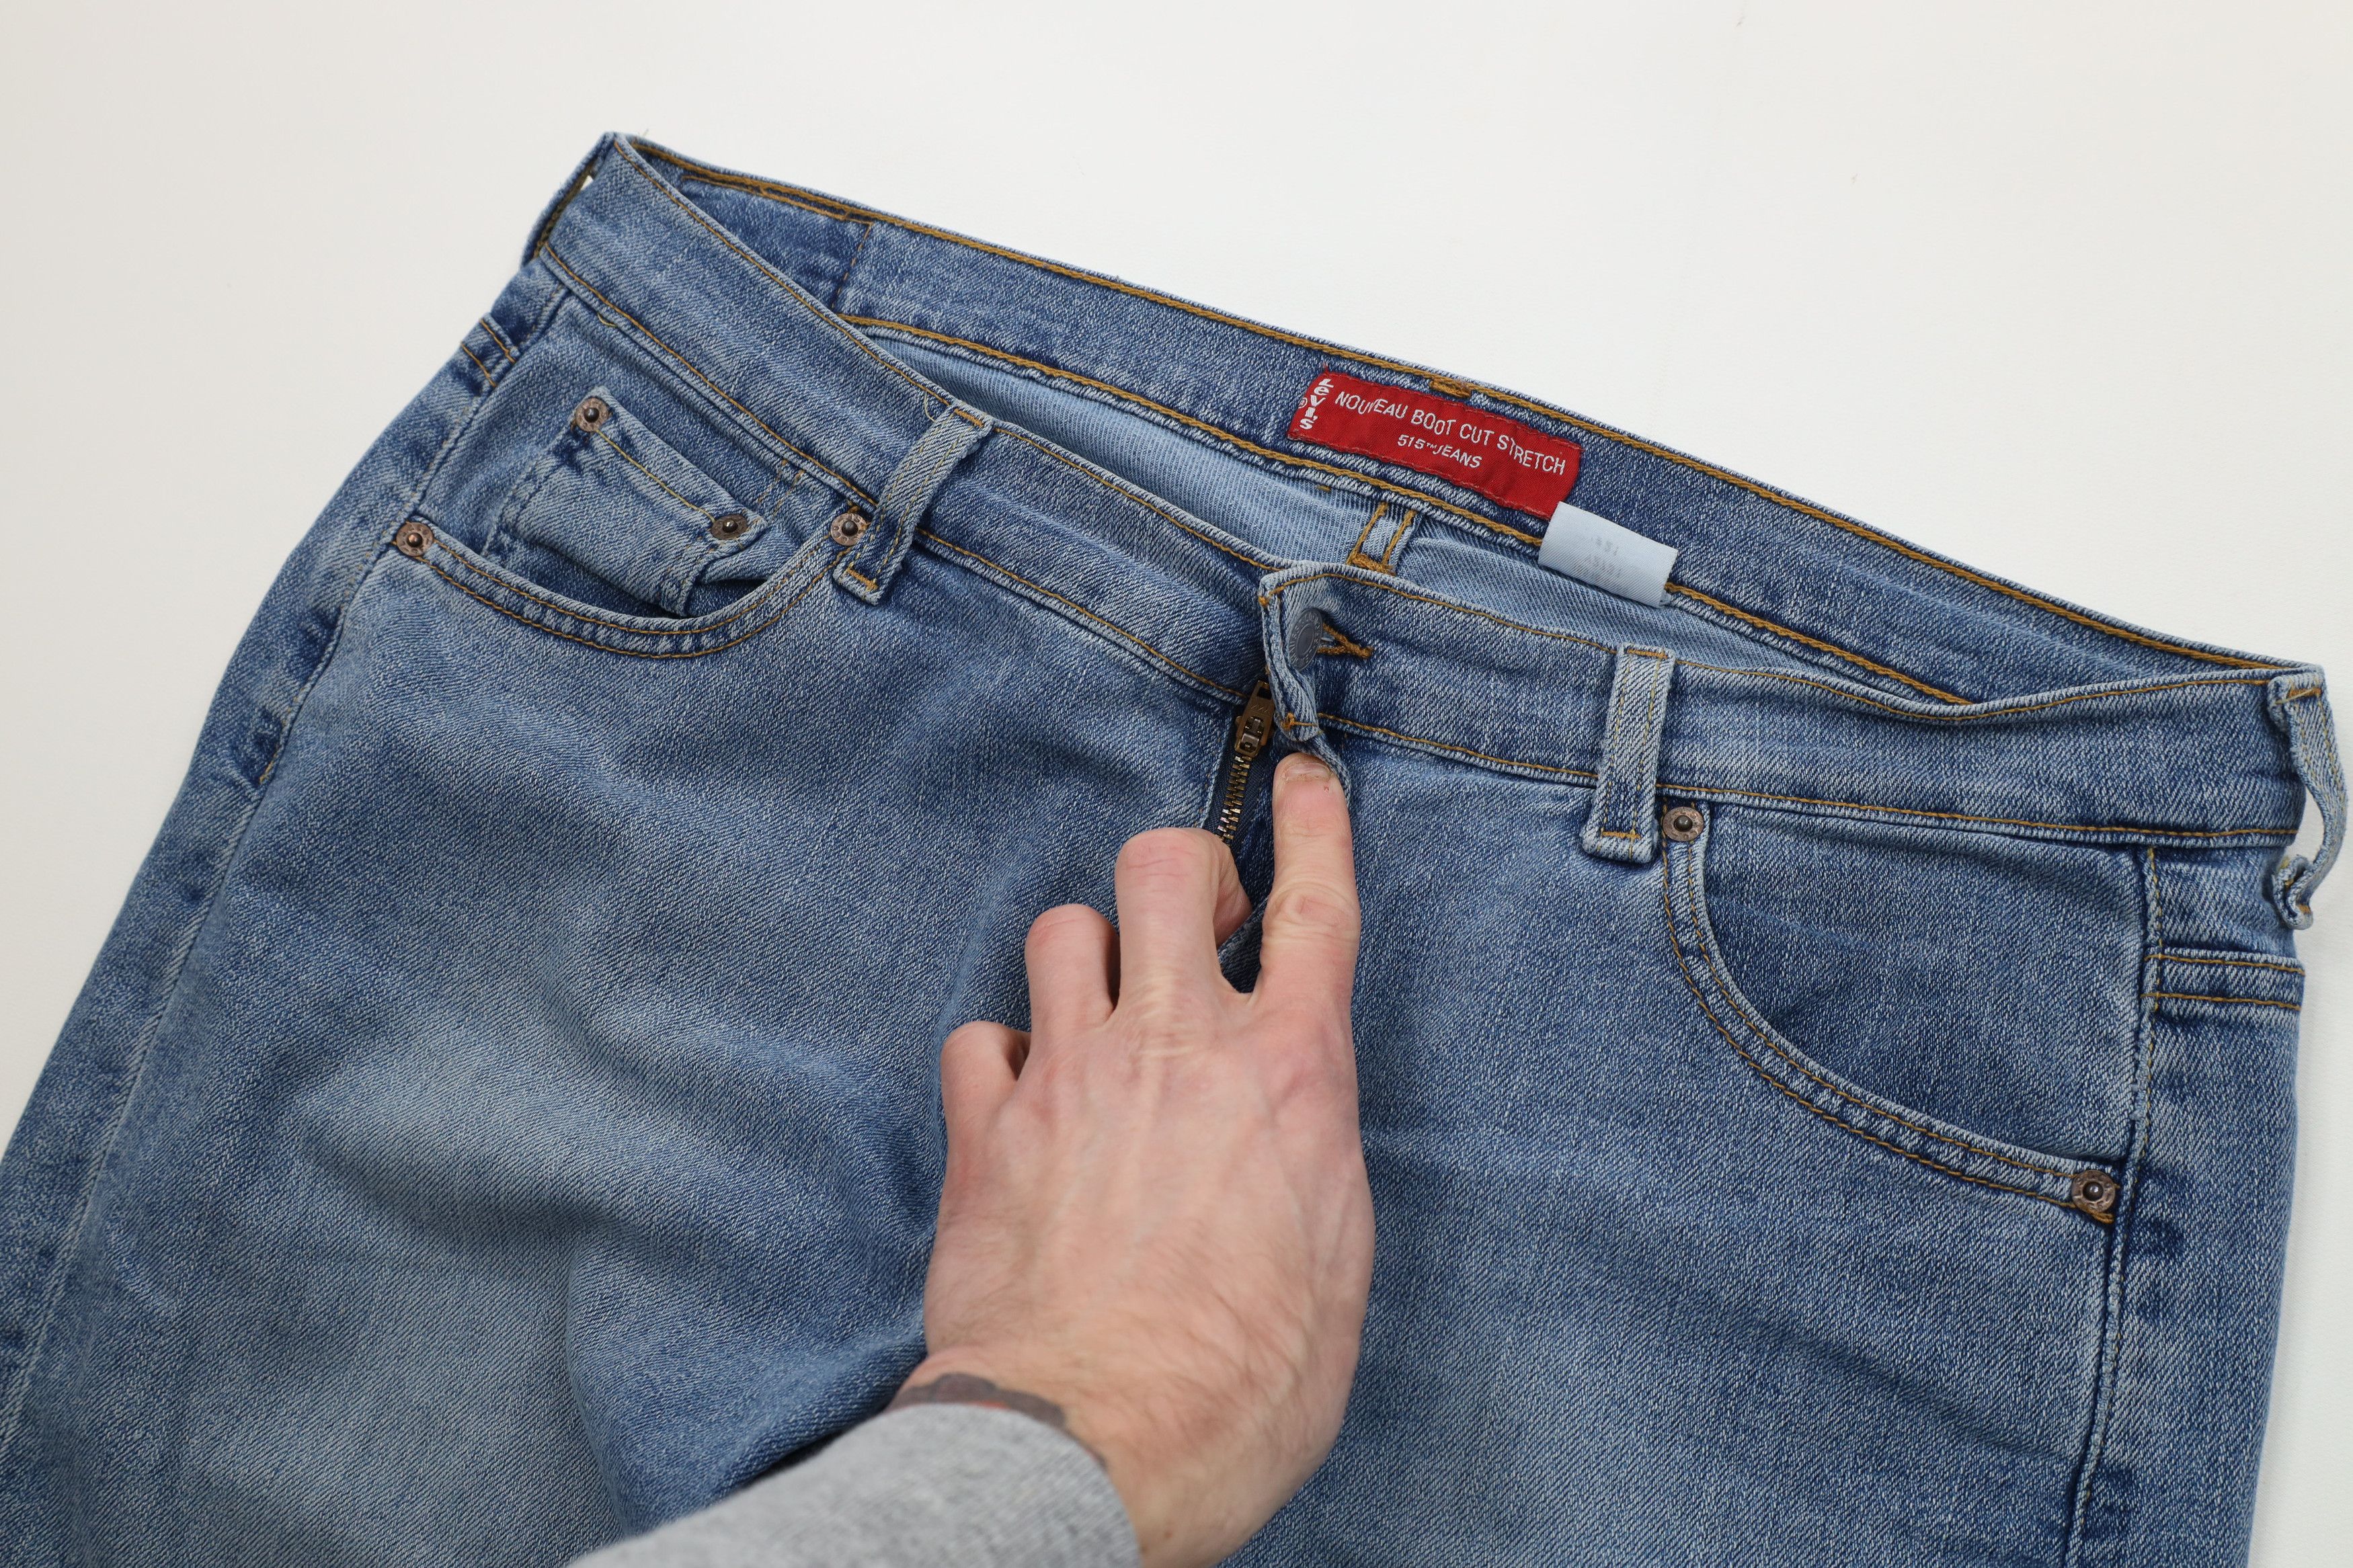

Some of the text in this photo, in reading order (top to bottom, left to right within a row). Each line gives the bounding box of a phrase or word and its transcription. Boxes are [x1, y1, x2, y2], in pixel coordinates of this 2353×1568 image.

[1410, 409, 1457, 436] BOOT
[1459, 423, 1495, 446] CUT
[1497, 434, 1566, 476] STRETCH
